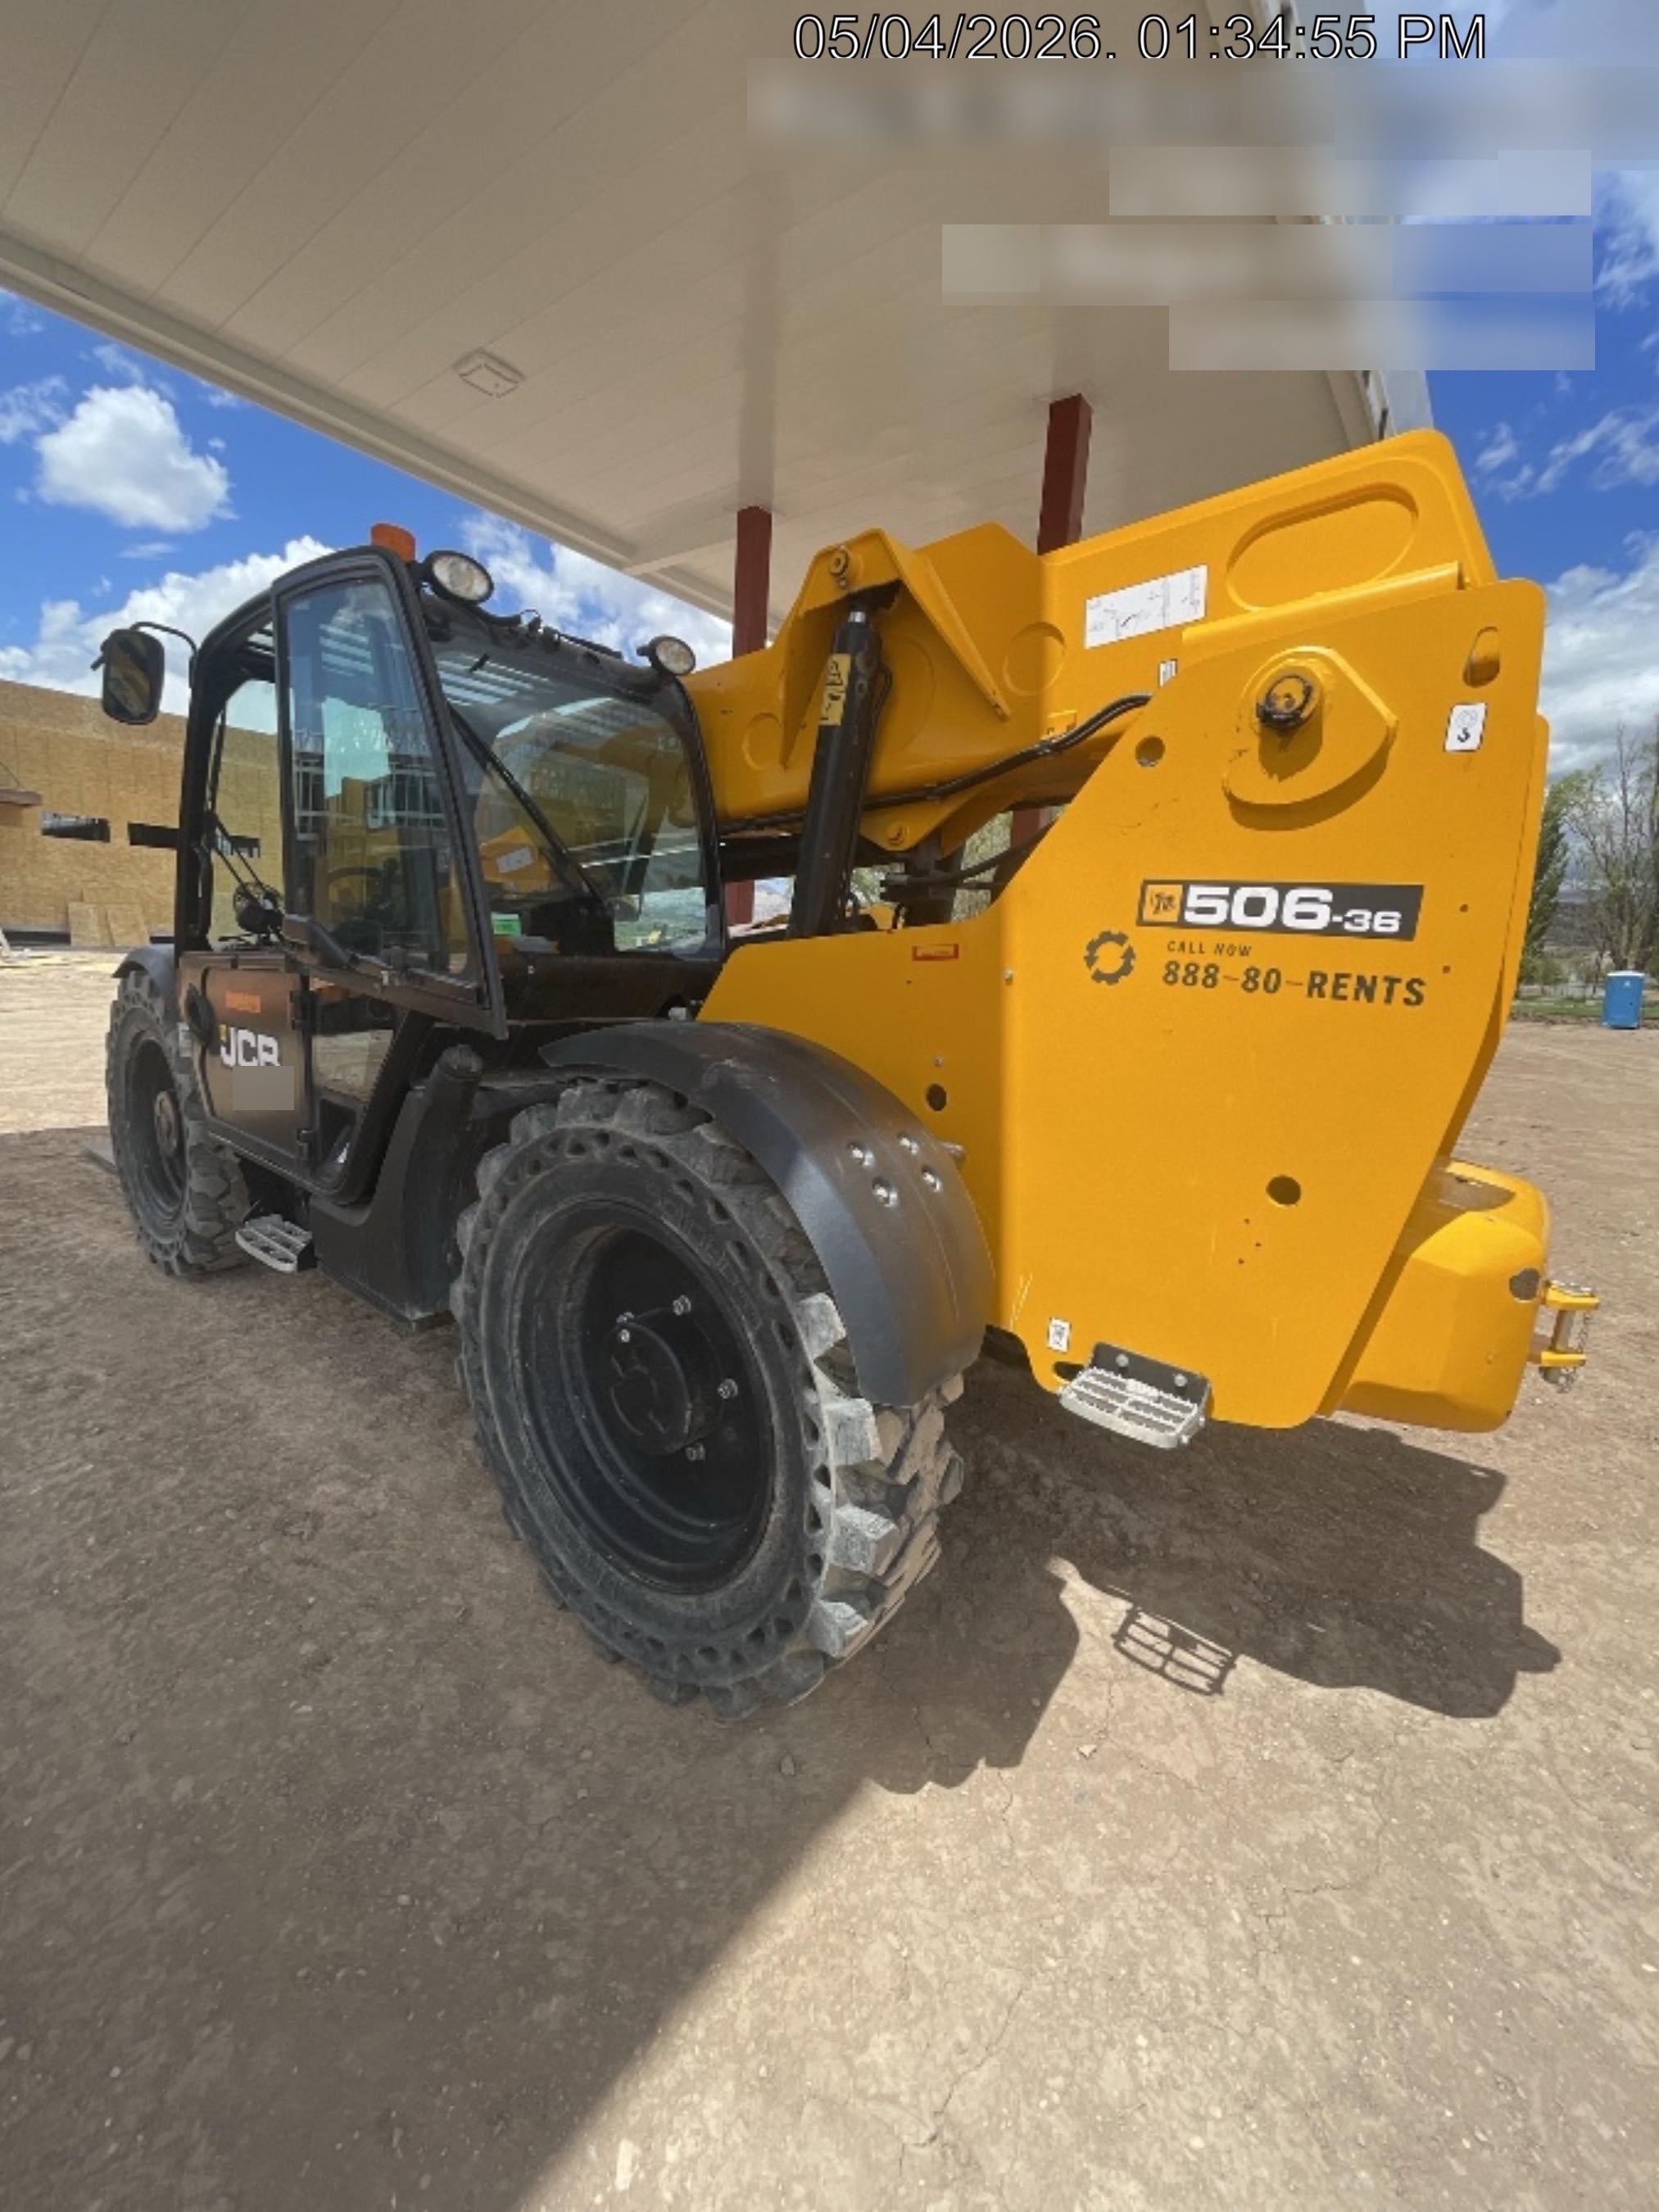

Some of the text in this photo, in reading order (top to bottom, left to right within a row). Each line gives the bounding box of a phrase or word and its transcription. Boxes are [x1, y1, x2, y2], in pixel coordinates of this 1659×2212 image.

[1184, 885, 1402, 932] 506-36
[1167, 941, 1253, 957] CALL NOW
